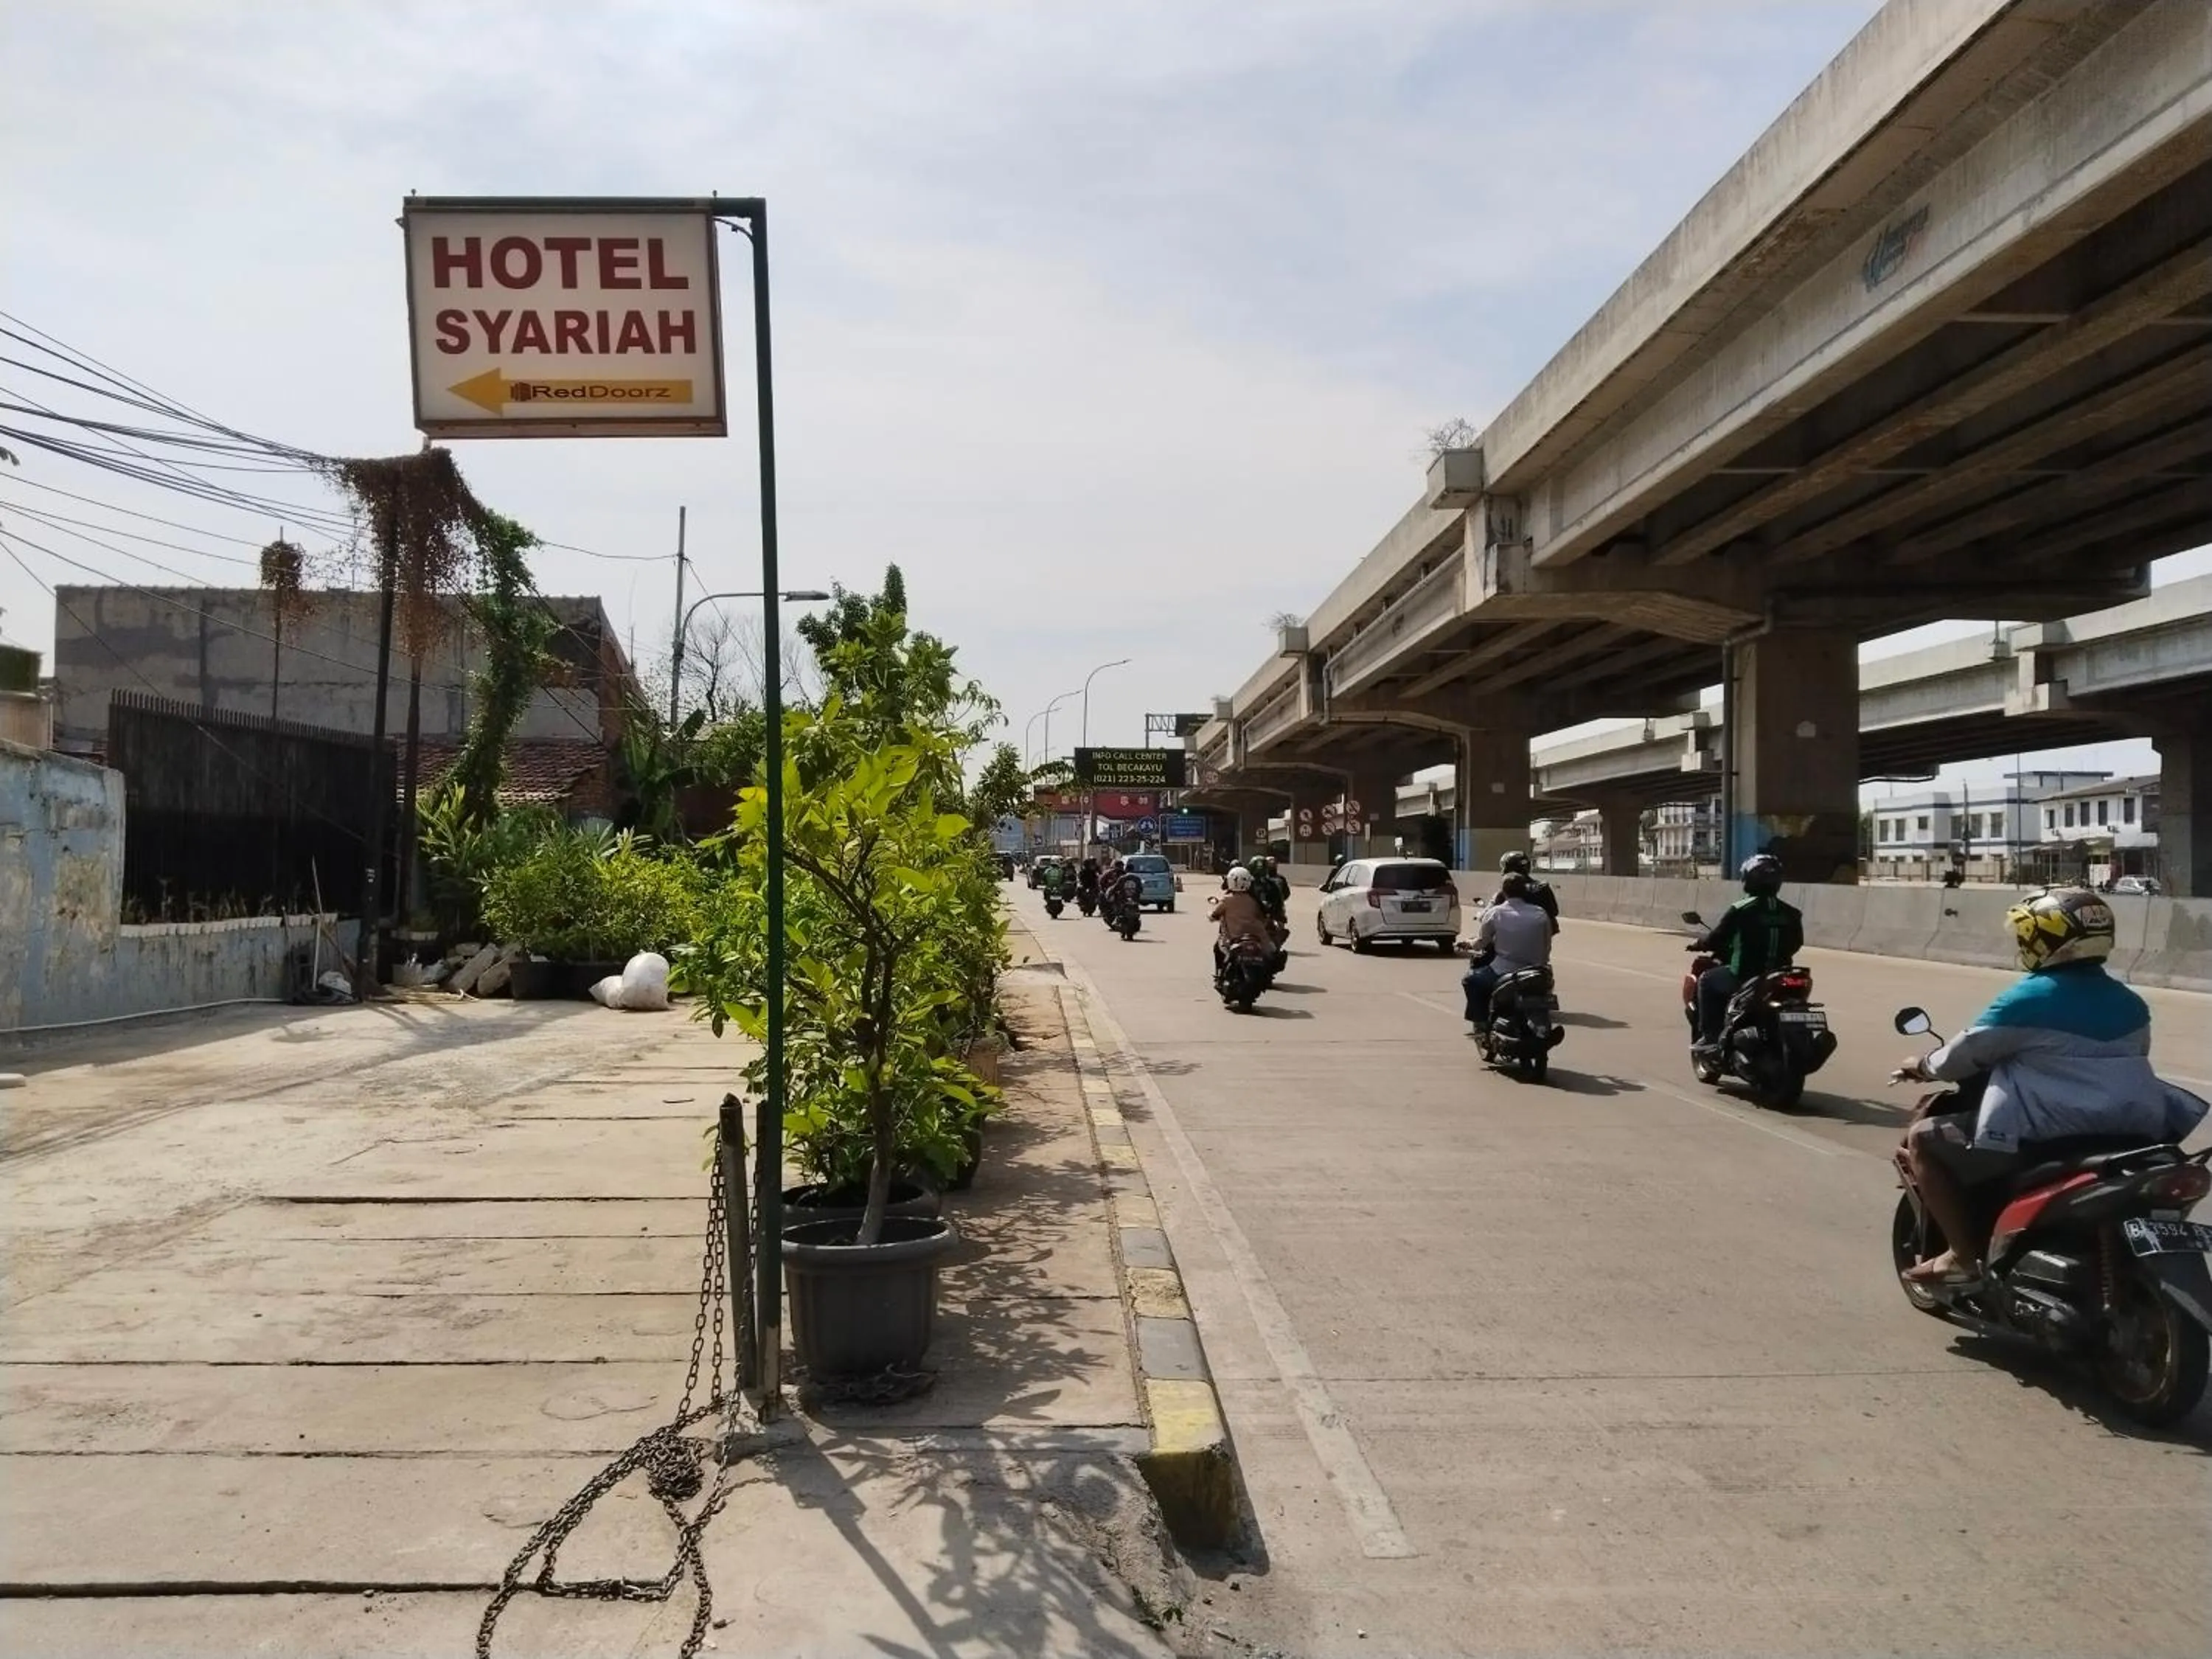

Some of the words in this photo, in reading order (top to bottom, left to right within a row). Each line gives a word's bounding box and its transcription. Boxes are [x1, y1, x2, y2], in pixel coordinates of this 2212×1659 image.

[431, 237, 689, 290] HOTEL
[435, 309, 696, 355] SYARIAH
[531, 384, 671, 399] RedDoorz
[1092, 751, 1111, 760] INFO
[1113, 751, 1133, 760] CALL
[1135, 752, 1167, 760] CENTER
[1097, 763, 1114, 772] TOL
